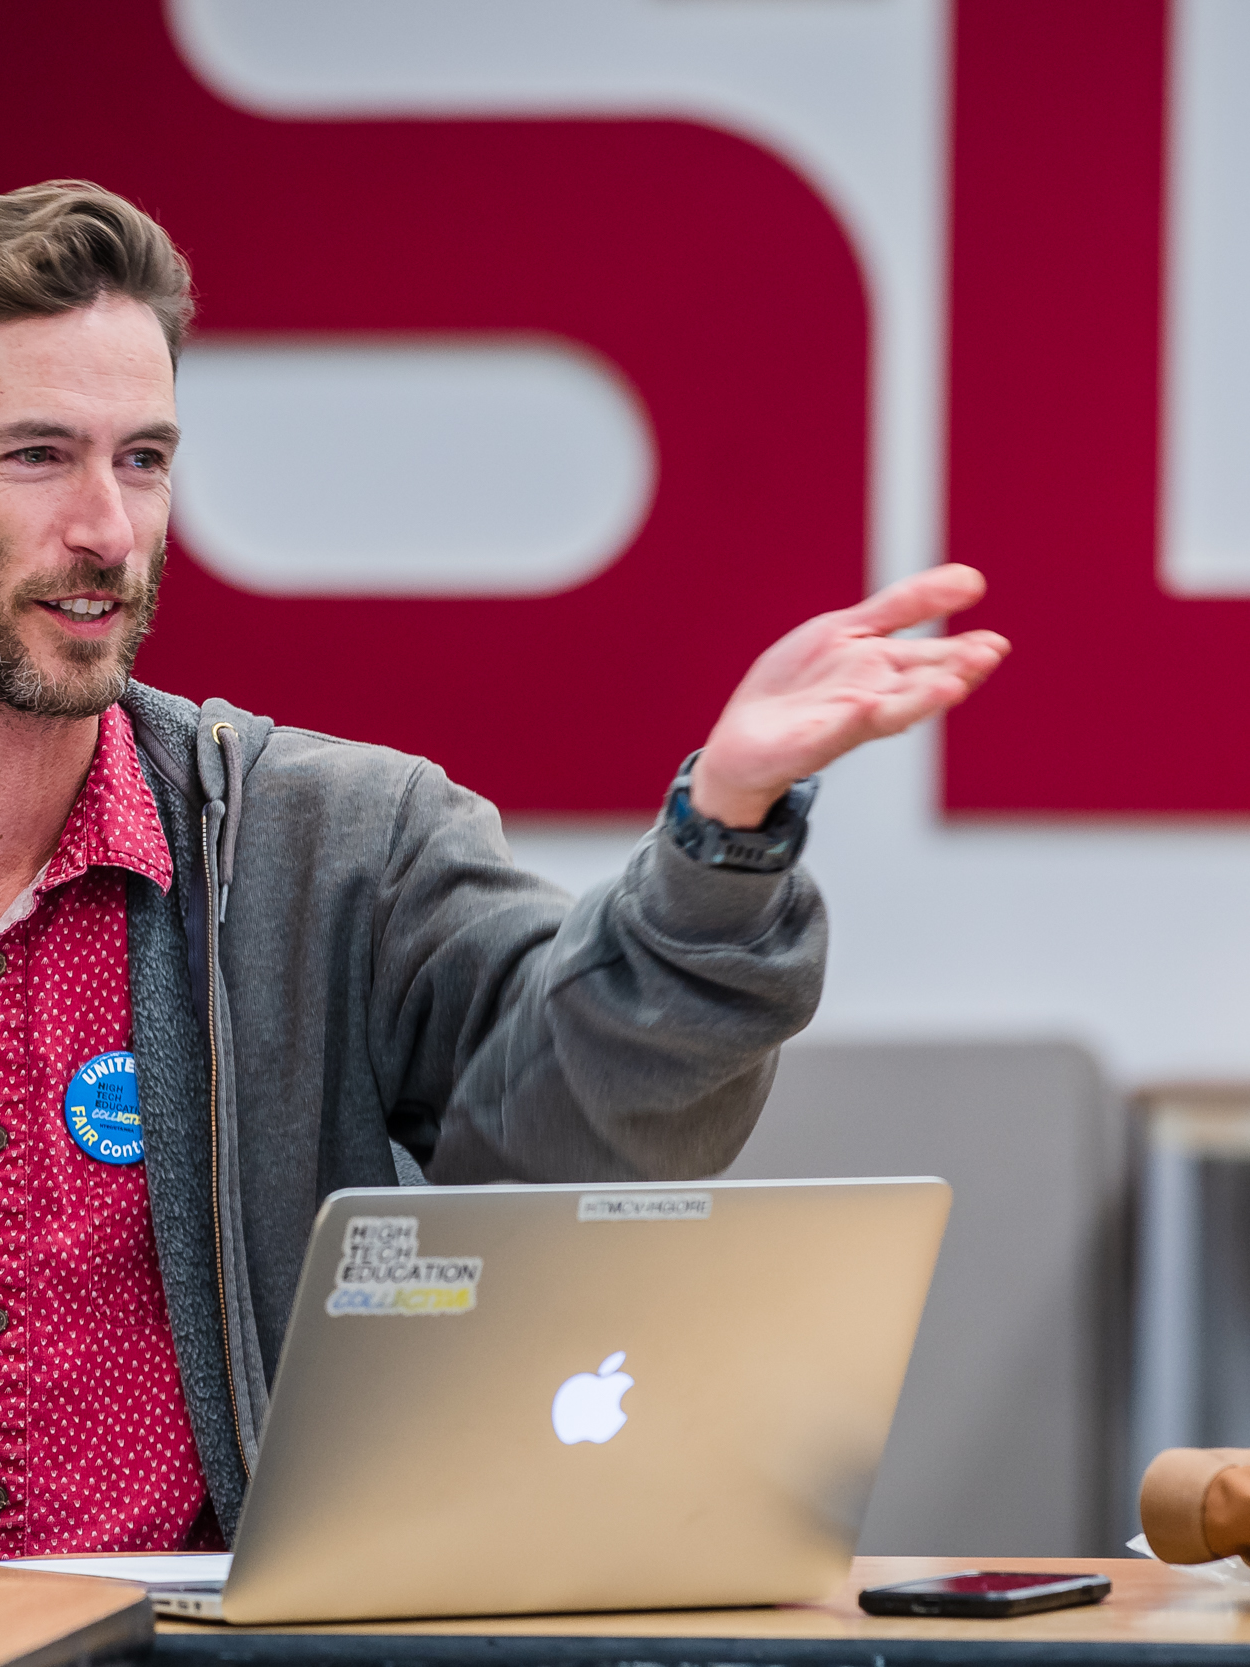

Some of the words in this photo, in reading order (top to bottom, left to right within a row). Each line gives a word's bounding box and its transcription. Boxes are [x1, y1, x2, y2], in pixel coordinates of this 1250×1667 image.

[96, 1091, 122, 1103] TECH
[97, 1082, 124, 1094] HIGH
[94, 1099, 140, 1114] EDUCATI
[71, 1106, 98, 1146] FAIR
[350, 1223, 413, 1244] HIGH
[347, 1243, 413, 1265] TECH
[341, 1263, 479, 1284] EDUCATION
